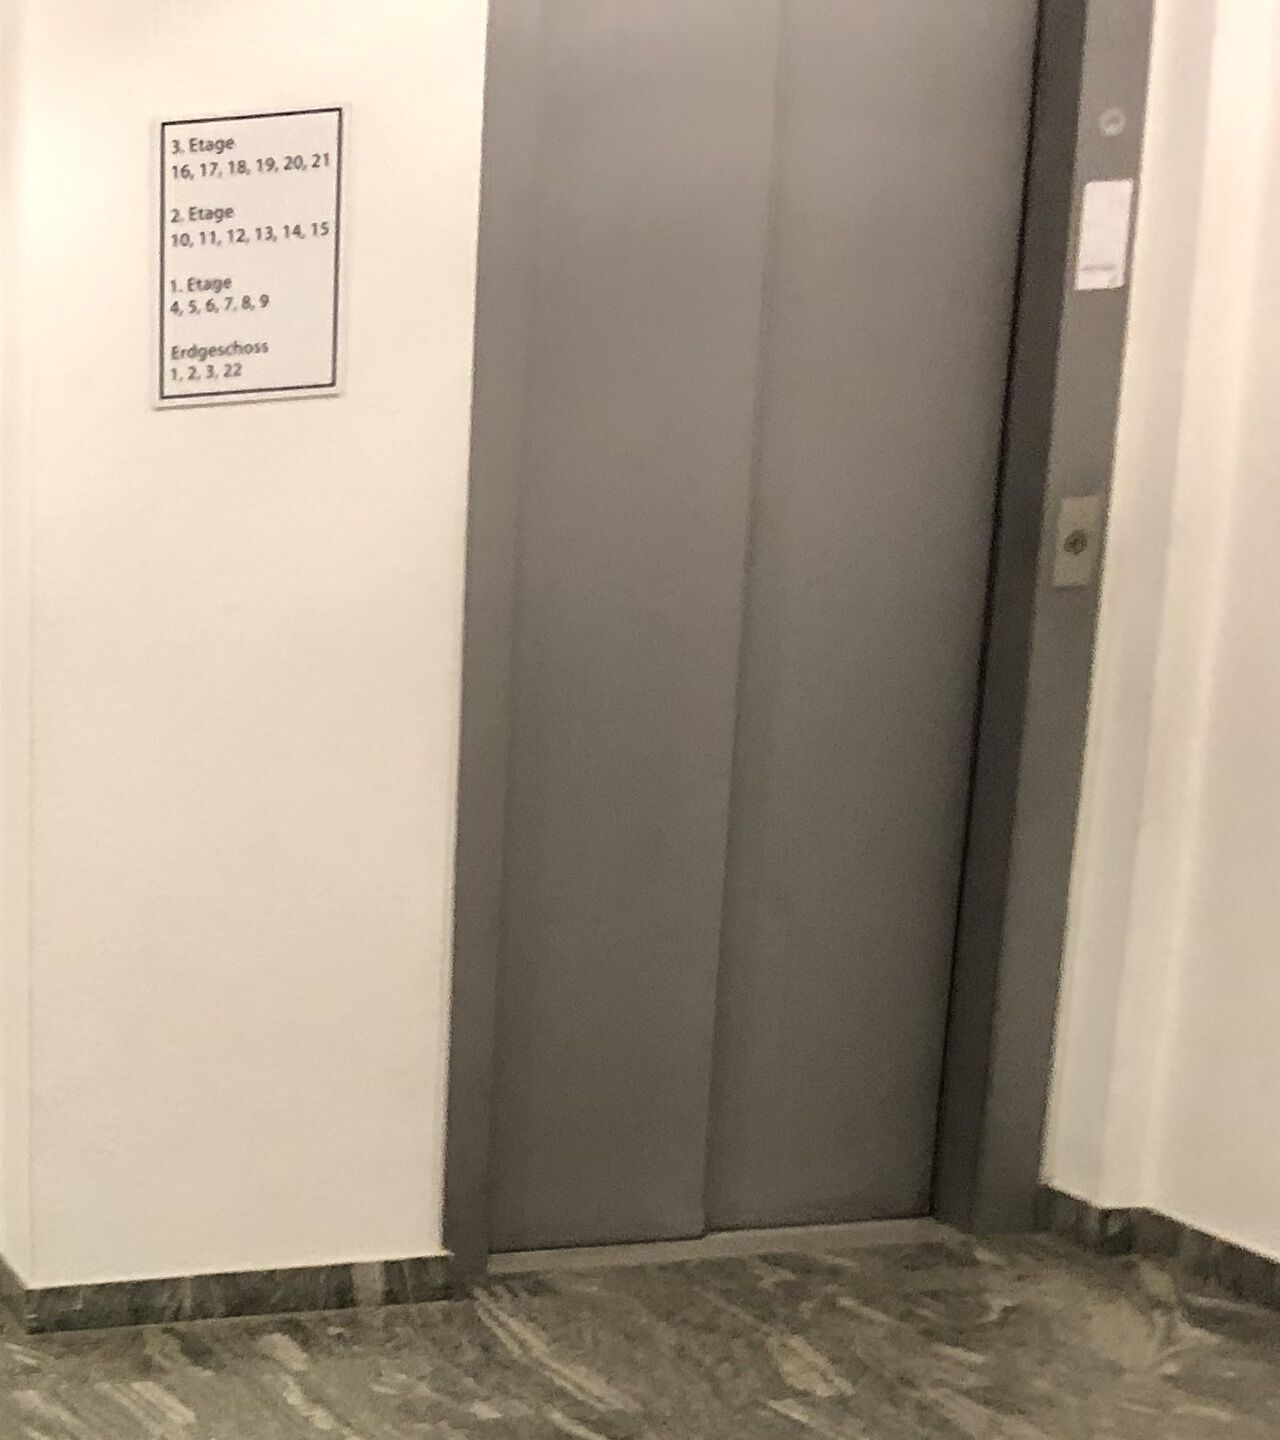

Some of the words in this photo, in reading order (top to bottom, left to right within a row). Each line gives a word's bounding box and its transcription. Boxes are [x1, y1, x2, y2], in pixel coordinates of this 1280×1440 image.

[189, 137, 235, 155] Etage
[311, 152, 330, 168] 21
[189, 206, 234, 223] Etage
[311, 221, 330, 236] 15
[187, 277, 232, 293] Etage
[259, 294, 270, 308] 9
[171, 340, 269, 361] Erdgeschoss
[223, 362, 242, 378] 22
